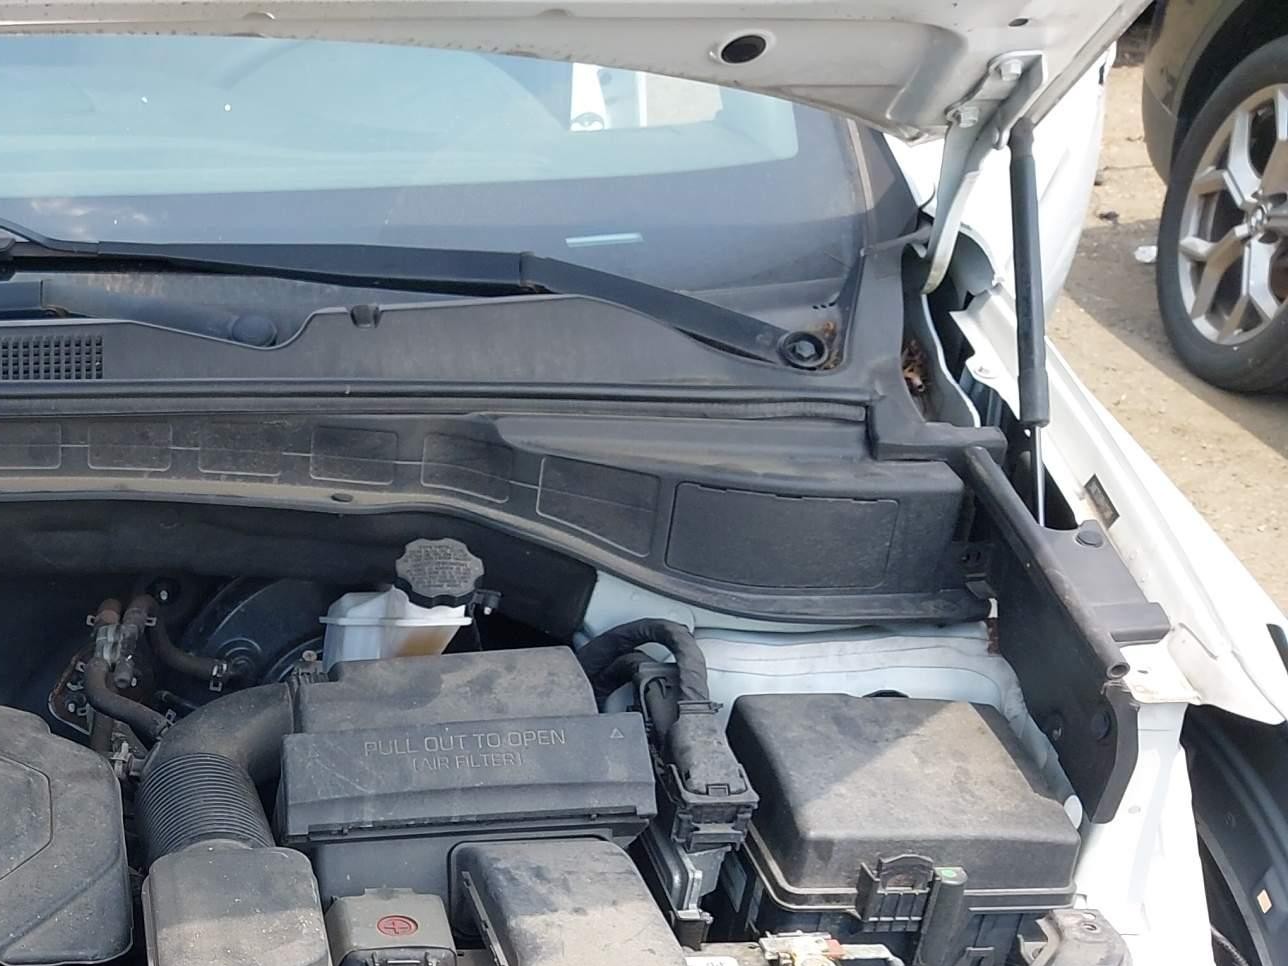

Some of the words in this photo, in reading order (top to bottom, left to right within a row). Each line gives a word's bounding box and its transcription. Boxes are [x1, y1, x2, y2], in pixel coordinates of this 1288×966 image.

[364, 739, 419, 757] PULL
[424, 734, 466, 753] OUT
[473, 732, 501, 749] TO
[507, 729, 567, 747] OPEN
